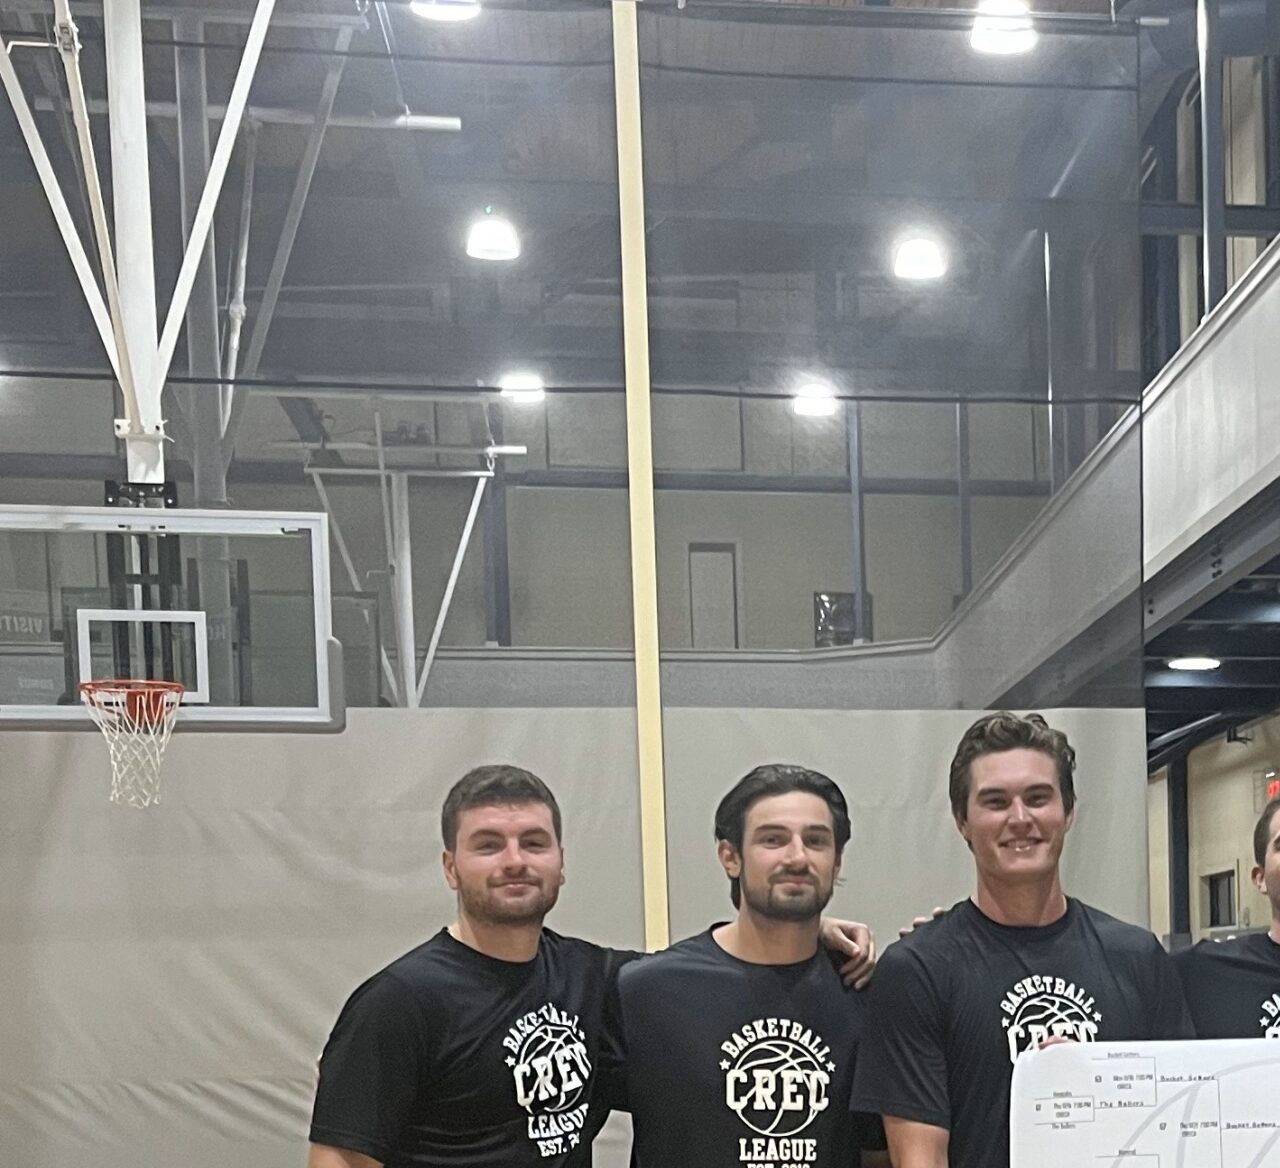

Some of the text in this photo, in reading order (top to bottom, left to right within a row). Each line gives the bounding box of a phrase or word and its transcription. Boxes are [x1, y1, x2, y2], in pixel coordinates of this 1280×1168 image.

[1000, 974, 1095, 1016] BASKETBALL
[502, 1002, 580, 1054] BASKETAL
[720, 1017, 831, 1064] BASKETBALL
[725, 1068, 831, 1111] CREC
[527, 1102, 590, 1140] LEAGU
[537, 1138, 568, 1158] EST.
[738, 1137, 818, 1162] LEAGUE
